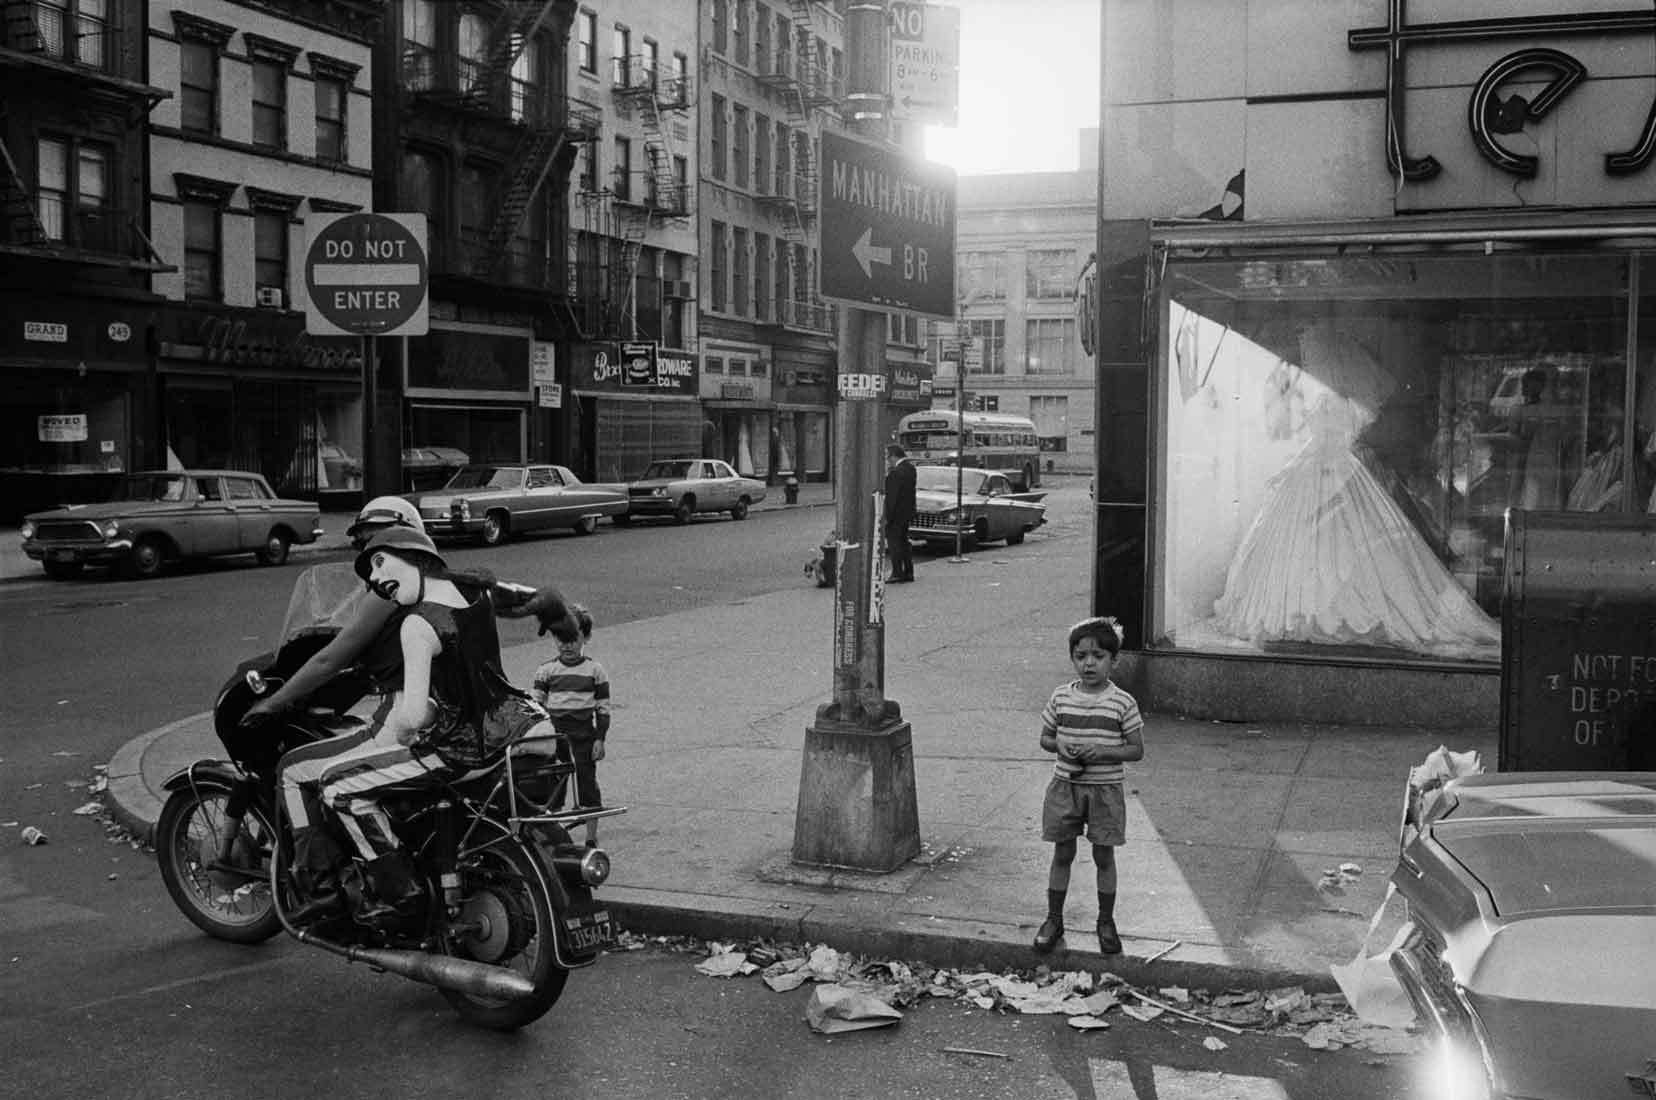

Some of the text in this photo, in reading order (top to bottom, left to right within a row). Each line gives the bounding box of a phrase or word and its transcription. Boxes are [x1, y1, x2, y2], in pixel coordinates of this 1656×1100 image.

[892, 7, 922, 36] NO
[895, 45, 952, 65] PARKIN
[832, 159, 948, 228] MANHATTAN
[325, 240, 407, 259] DO NOT
[903, 243, 929, 285] BR
[334, 291, 401, 310] ENTER
[26, 323, 65, 335] GRAND
[657, 358, 693, 377] RDWARE
[837, 373, 888, 392] EEDE
[1574, 654, 1656, 682] NOT FO
